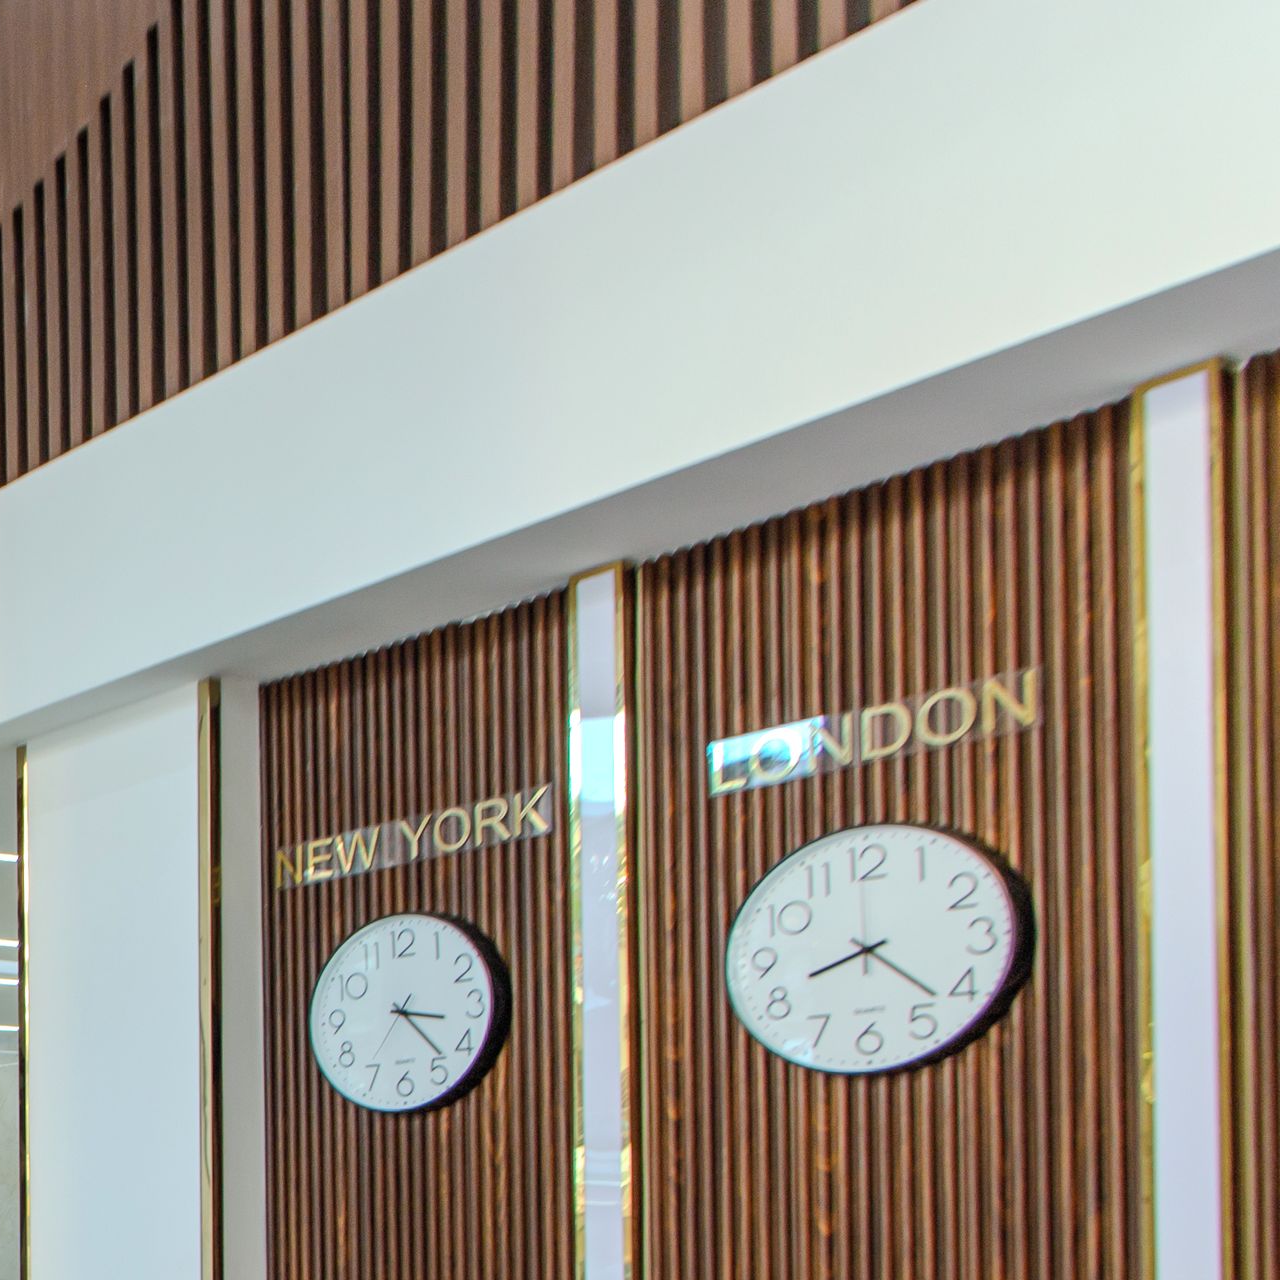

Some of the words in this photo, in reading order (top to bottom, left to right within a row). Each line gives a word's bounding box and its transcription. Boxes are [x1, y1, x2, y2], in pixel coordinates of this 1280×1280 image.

[709, 669, 1039, 795] LONDON
[274, 826, 382, 889] NEW
[400, 782, 553, 861] YORK
[847, 843, 888, 883] 12
[915, 846, 925, 883] 1
[803, 862, 831, 900] 11
[947, 871, 979, 911] 2
[768, 899, 813, 937] 10
[391, 927, 417, 959] 12
[433, 930, 442, 960] 1
[966, 916, 999, 956] 3
[363, 941, 380, 971] 11
[453, 952, 474, 984] 2
[751, 947, 778, 980] 9
[339, 971, 369, 1002] 10
[948, 966, 979, 1002] 4
[466, 988, 485, 1019] 3
[766, 986, 791, 1020] 8
[329, 1009, 346, 1035] 9
[807, 1013, 831, 1048] 7
[909, 1002, 939, 1041] 5
[338, 1041, 355, 1068] 8
[454, 1028, 475, 1057] 4
[855, 1022, 883, 1056] 6
[365, 1063, 381, 1092] 7
[396, 1070, 415, 1098] 6
[430, 1056, 449, 1086] 5
